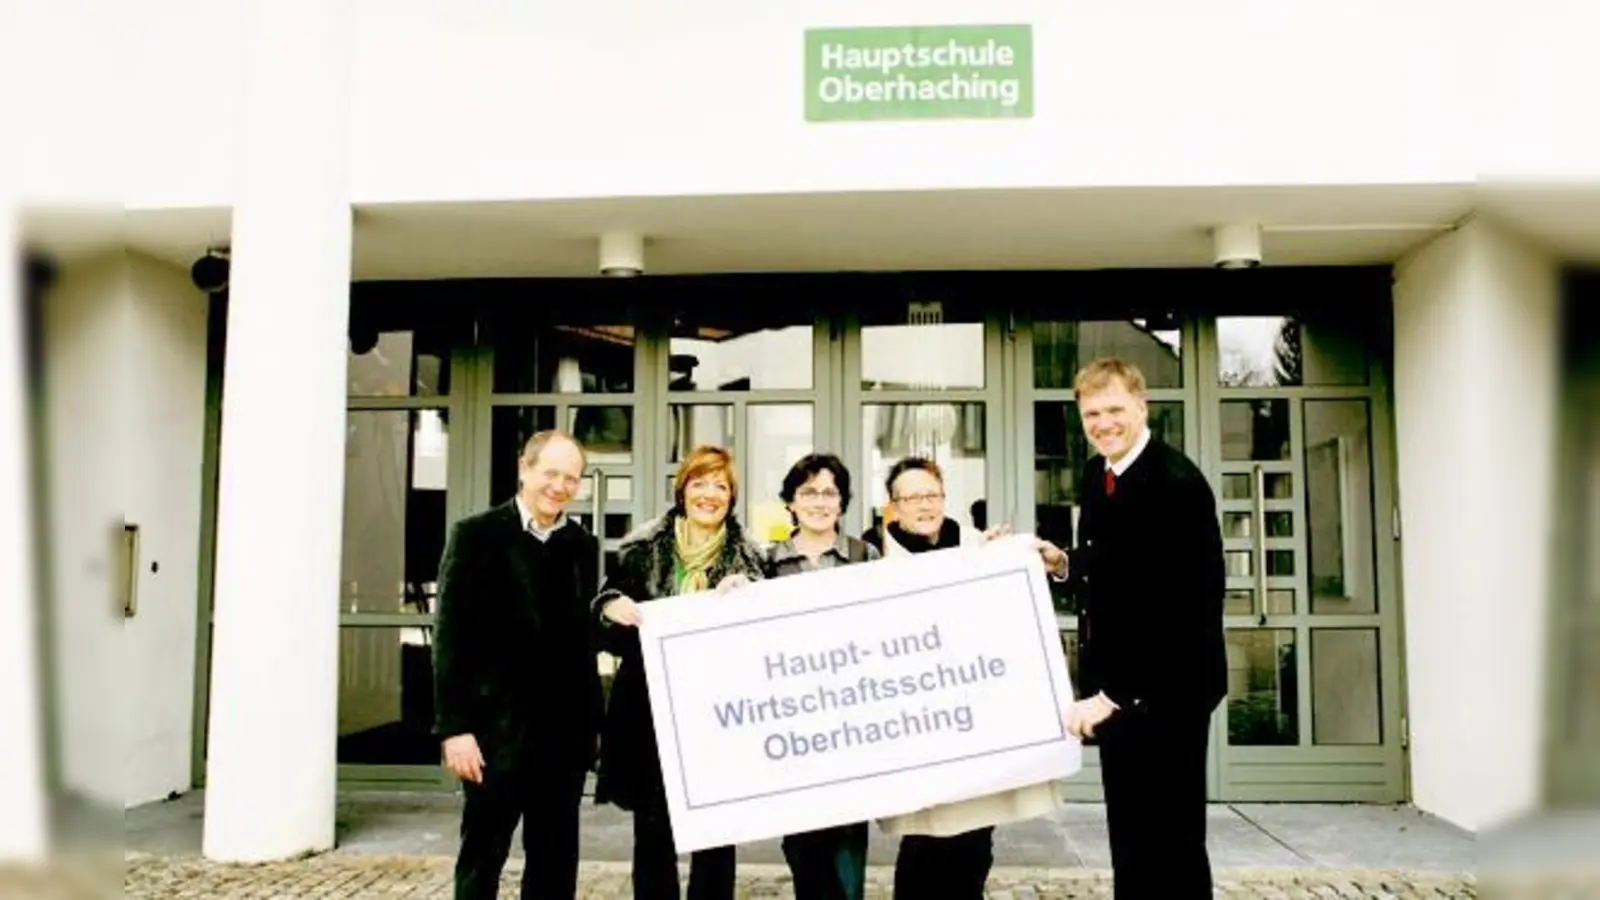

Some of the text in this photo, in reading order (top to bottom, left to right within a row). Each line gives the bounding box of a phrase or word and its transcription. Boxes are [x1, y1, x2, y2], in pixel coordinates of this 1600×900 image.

[821, 39, 1014, 74] Hauptschule
[819, 72, 1019, 106] Oberhaching
[764, 624, 943, 679] Haupt- und
[714, 654, 1007, 729] Wirtschaftsschule
[764, 703, 974, 762] Oberhaching
